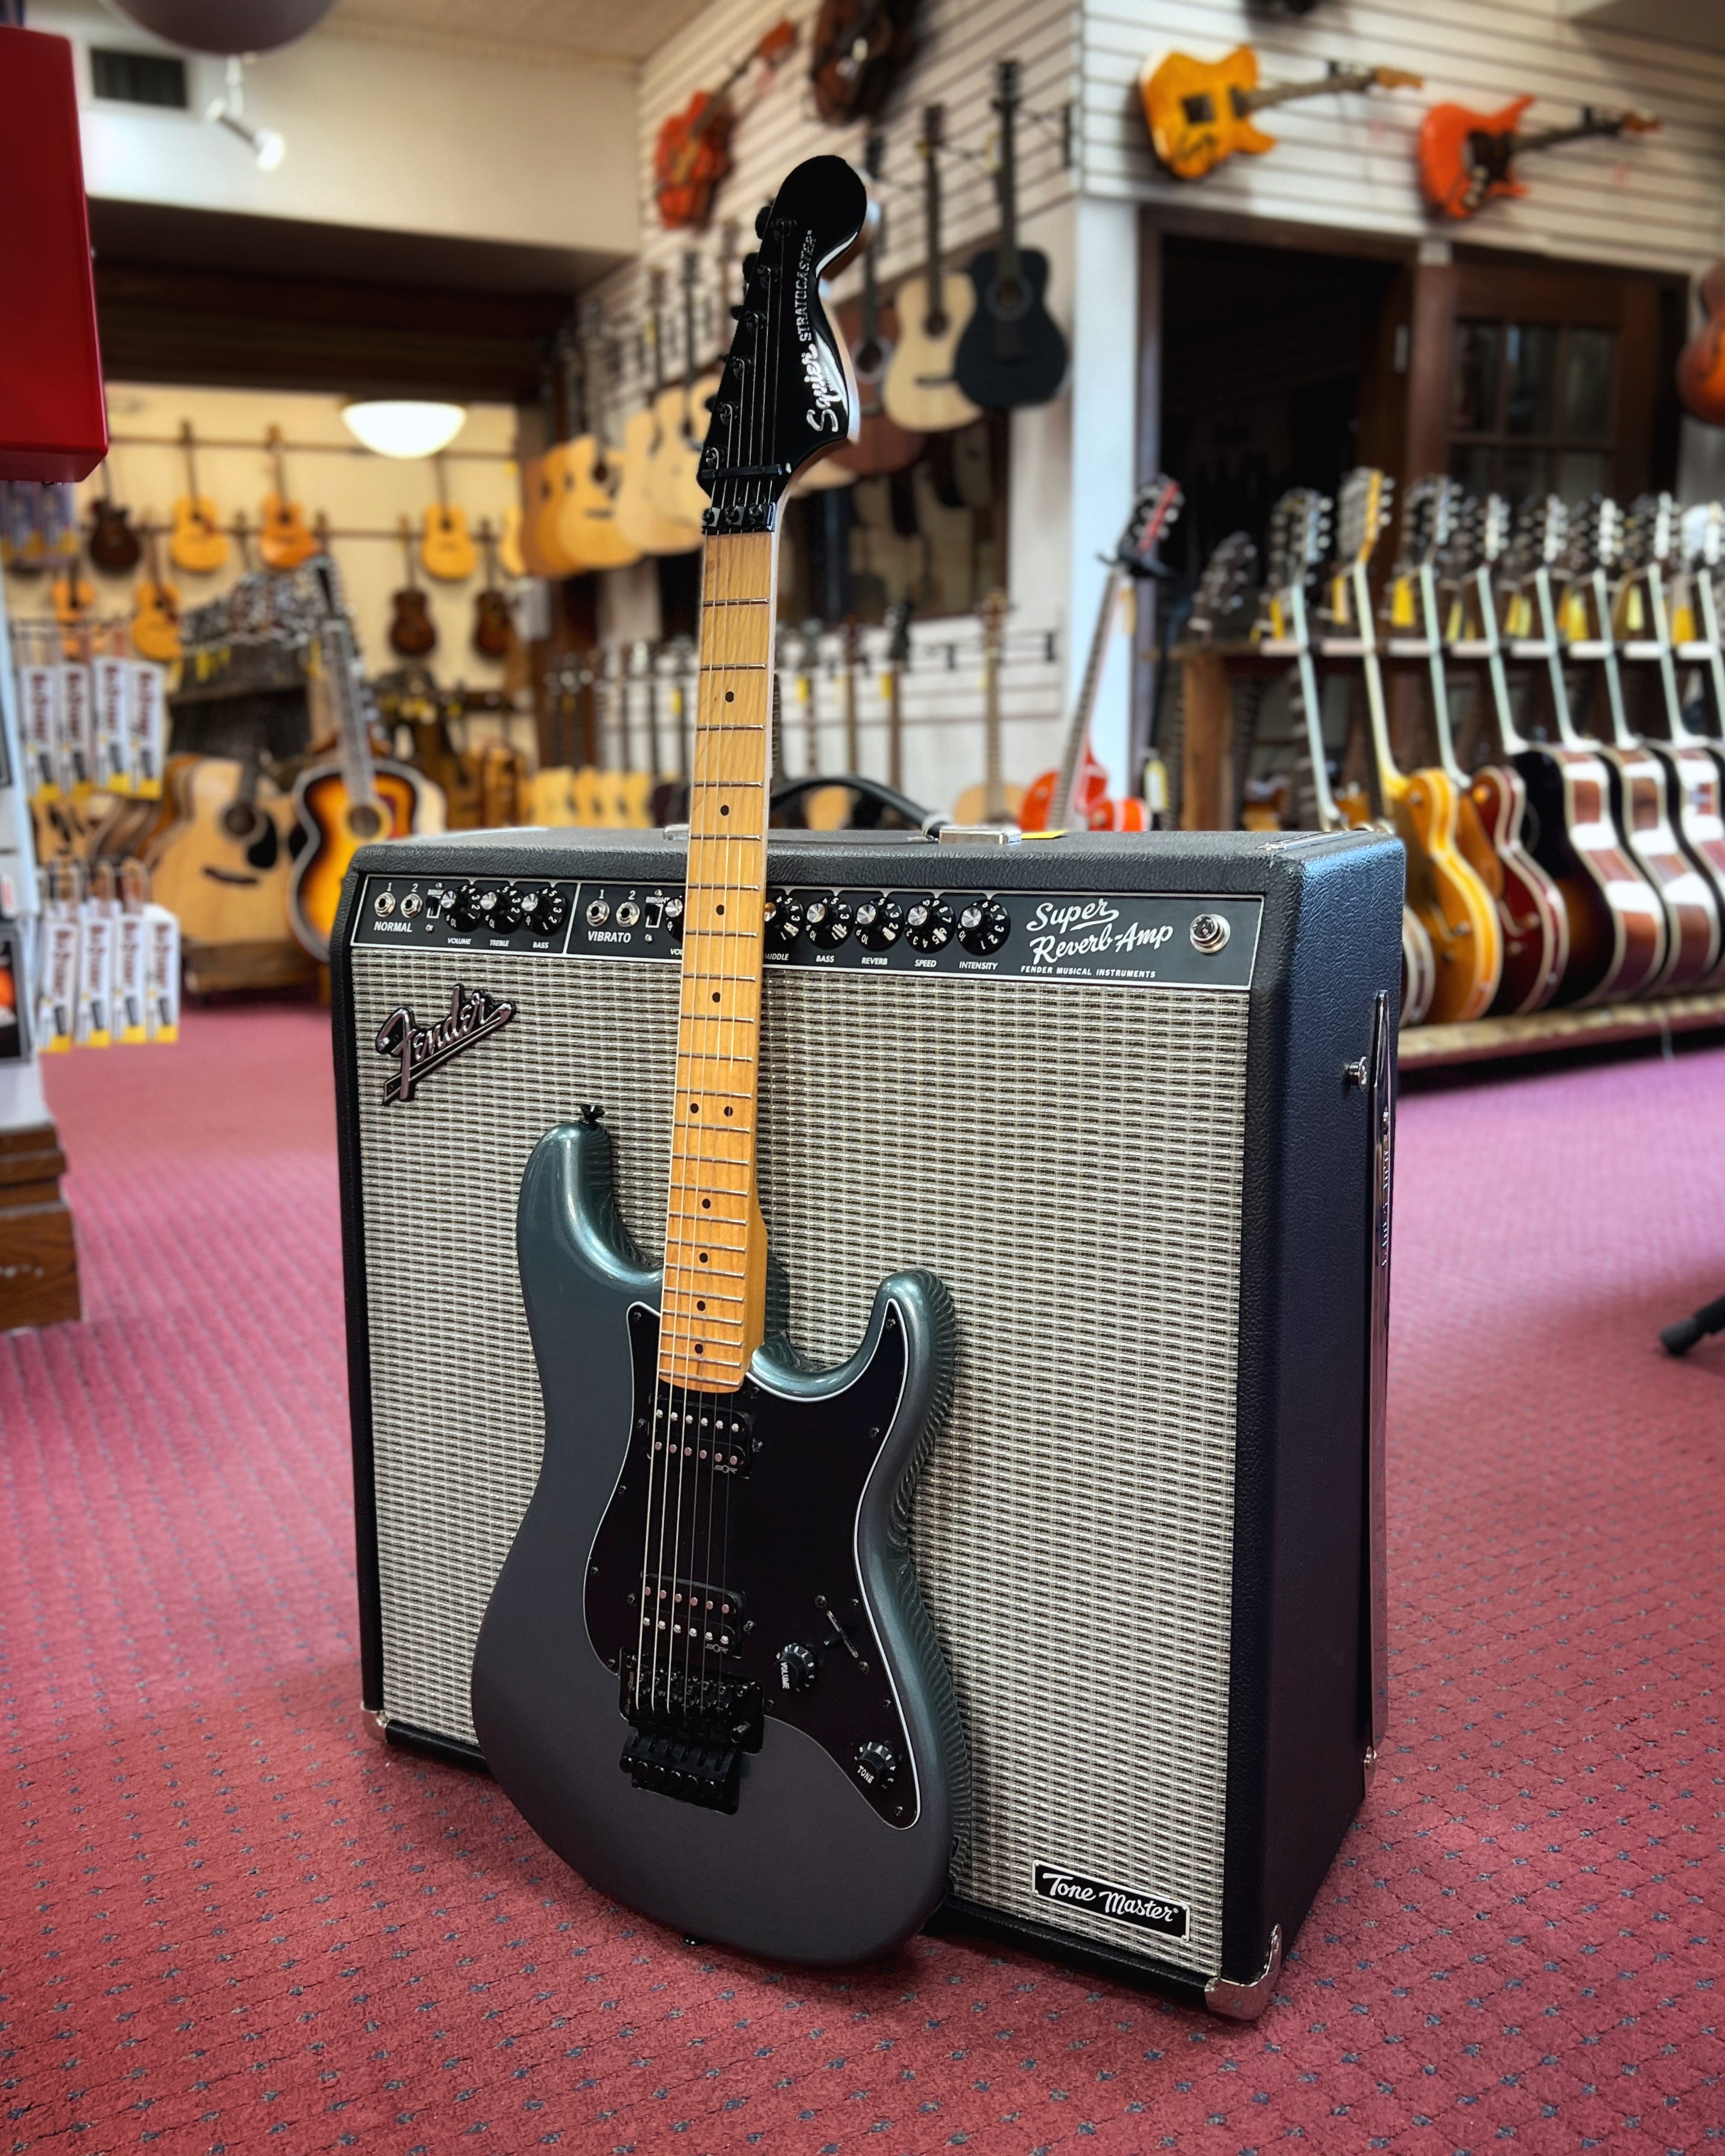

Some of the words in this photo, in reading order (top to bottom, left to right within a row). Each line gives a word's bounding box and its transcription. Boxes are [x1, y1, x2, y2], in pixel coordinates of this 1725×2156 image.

[794, 234, 817, 342] STRATOCASTER
[802, 343, 842, 432] Squier
[386, 881, 393, 892] 1
[411, 883, 419, 892] 2
[598, 889, 604, 899] 1
[628, 890, 636, 900] 2
[1025, 898, 1120, 934] Super
[373, 921, 413, 933] NORMAL
[906, 928, 913, 937] 2
[587, 931, 631, 943] VIBRATO
[861, 934, 869, 945] 10
[913, 936, 919, 945] 3
[932, 935, 940, 945] 5
[958, 930, 966, 942] 10
[988, 934, 998, 944] 2
[922, 938, 928, 948] 4
[1029, 922, 1174, 965] Reverb-Amp
[764, 953, 790, 961] MIDDLE
[815, 954, 835, 963] BASS
[861, 957, 888, 965] REVERB
[914, 959, 937, 968] SPEED
[959, 960, 998, 971] INTENSITY
[1020, 965, 1053, 974] FENDER
[1056, 966, 1092, 976] MUSICAL
[1096, 969, 1156, 978] INSTRUMENTS
[376, 984, 515, 1103] Fender
[780, 1661, 790, 1690] VOLUME
[857, 1765, 875, 1784] TONE
[1042, 1872, 1097, 1901] Tone
[1099, 1891, 1174, 1923] Master
